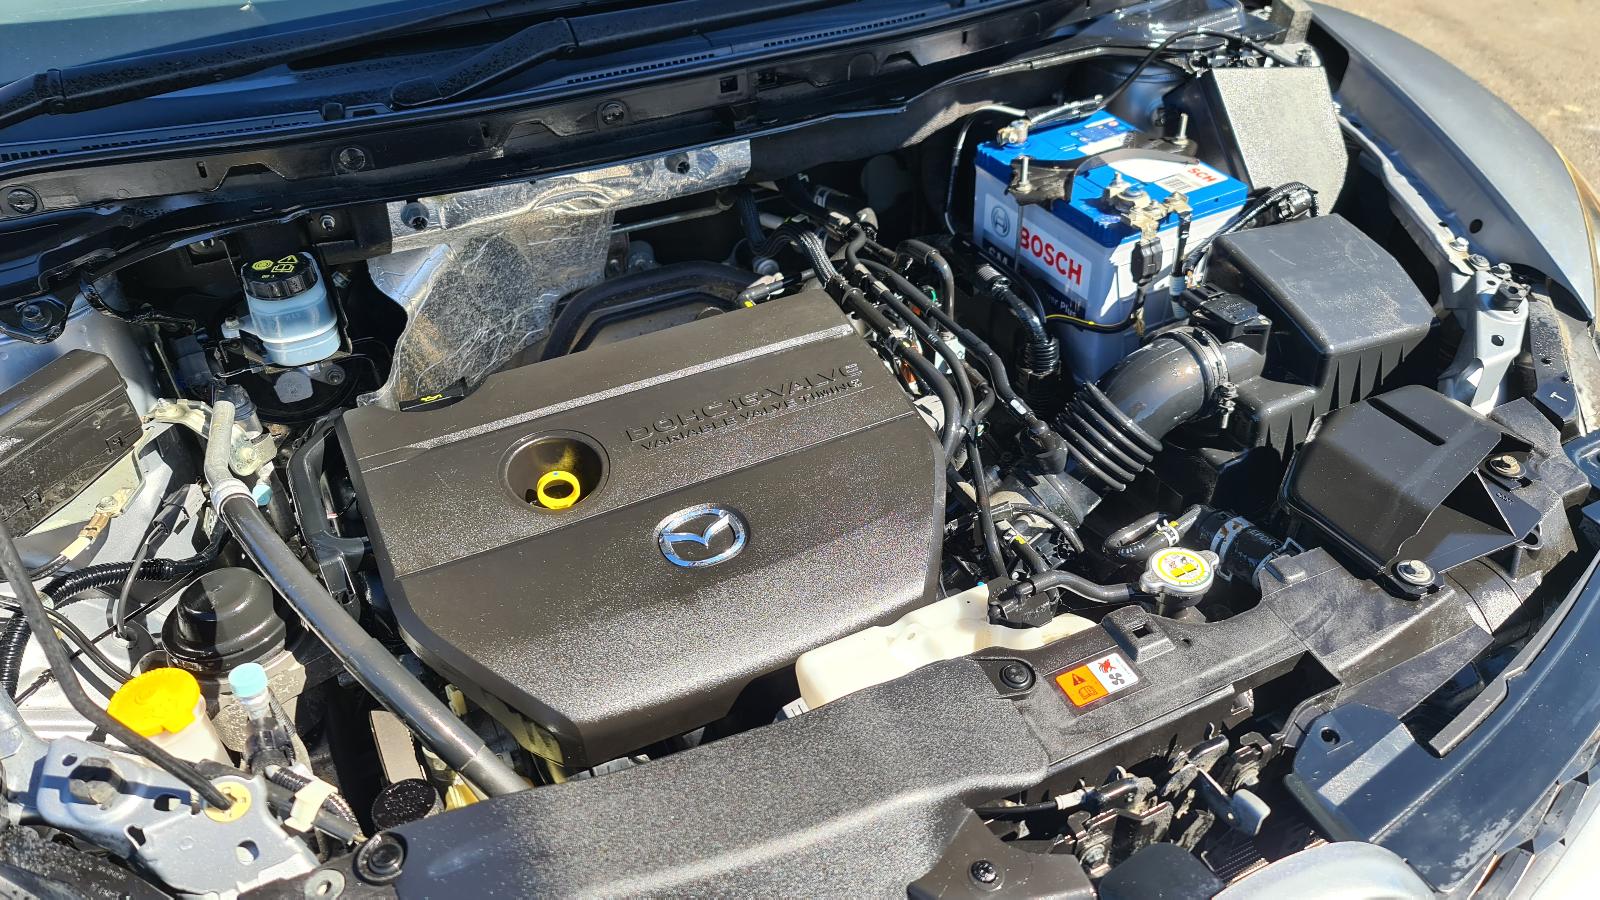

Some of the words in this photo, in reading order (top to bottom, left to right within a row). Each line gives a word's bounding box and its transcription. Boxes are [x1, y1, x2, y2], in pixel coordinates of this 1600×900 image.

[1188, 167, 1217, 183] SCH
[1020, 227, 1082, 286] BOSCH
[625, 400, 728, 443] DOHC
[640, 416, 737, 450] VARIABLE
[739, 399, 798, 422] VALVE
[798, 378, 863, 404] TIMING
